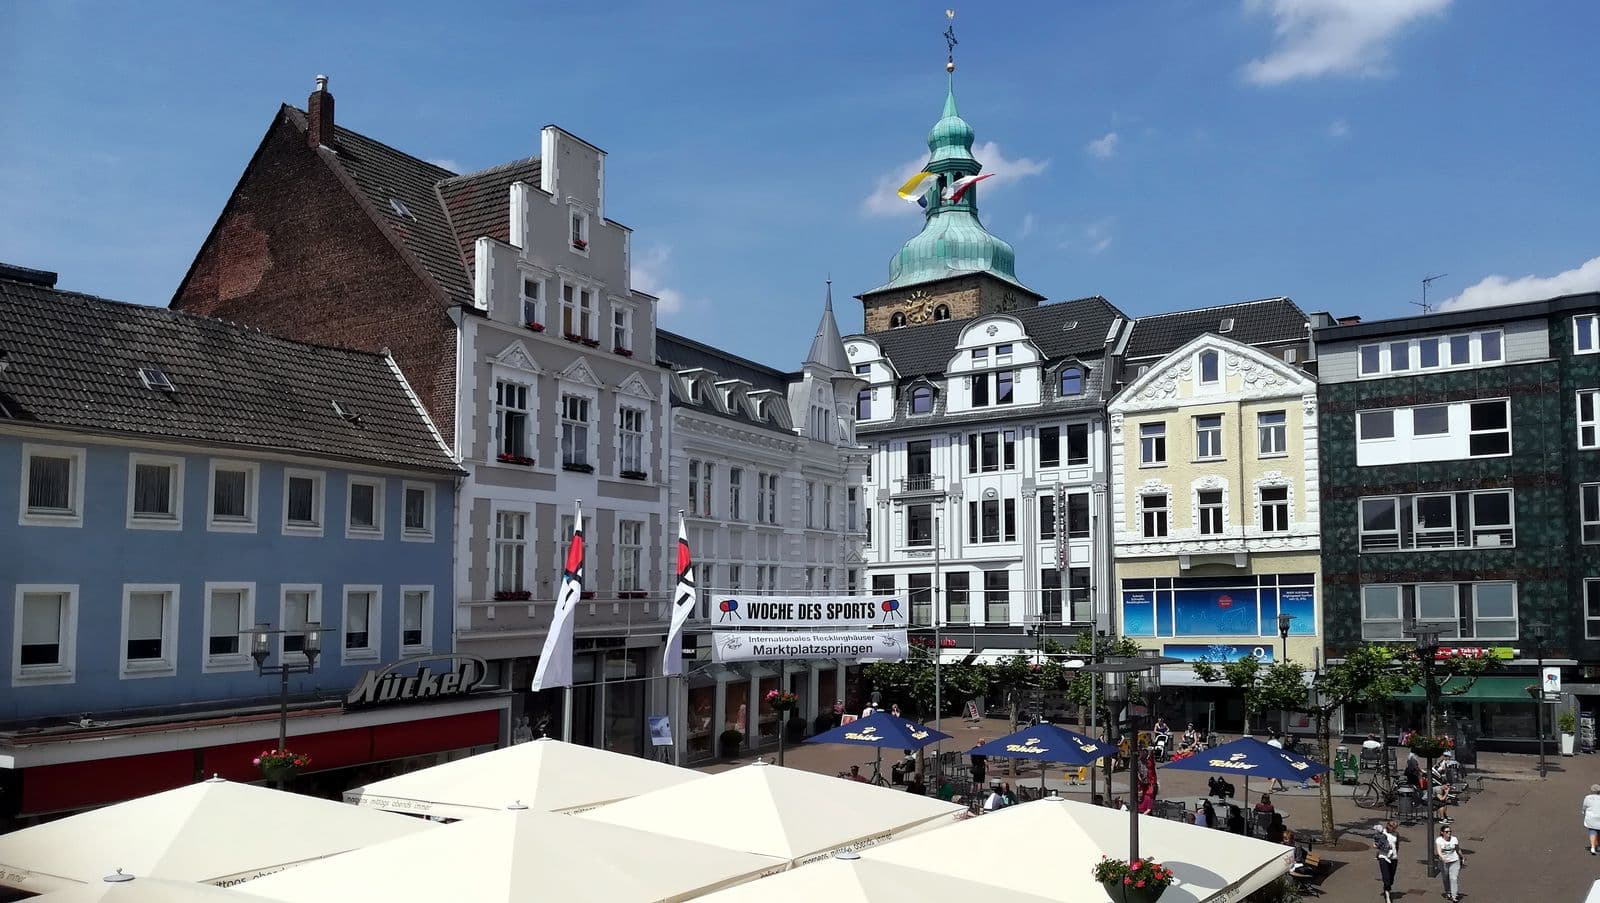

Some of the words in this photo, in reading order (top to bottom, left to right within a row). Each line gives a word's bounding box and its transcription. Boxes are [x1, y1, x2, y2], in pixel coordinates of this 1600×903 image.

[747, 602, 794, 620] WOCHE
[799, 602, 822, 620] DES
[826, 602, 876, 620] SPORTS
[748, 635, 811, 643] Internationales
[812, 634, 875, 643] Recklinghäuser
[752, 643, 873, 657] Marktplatzspringen
